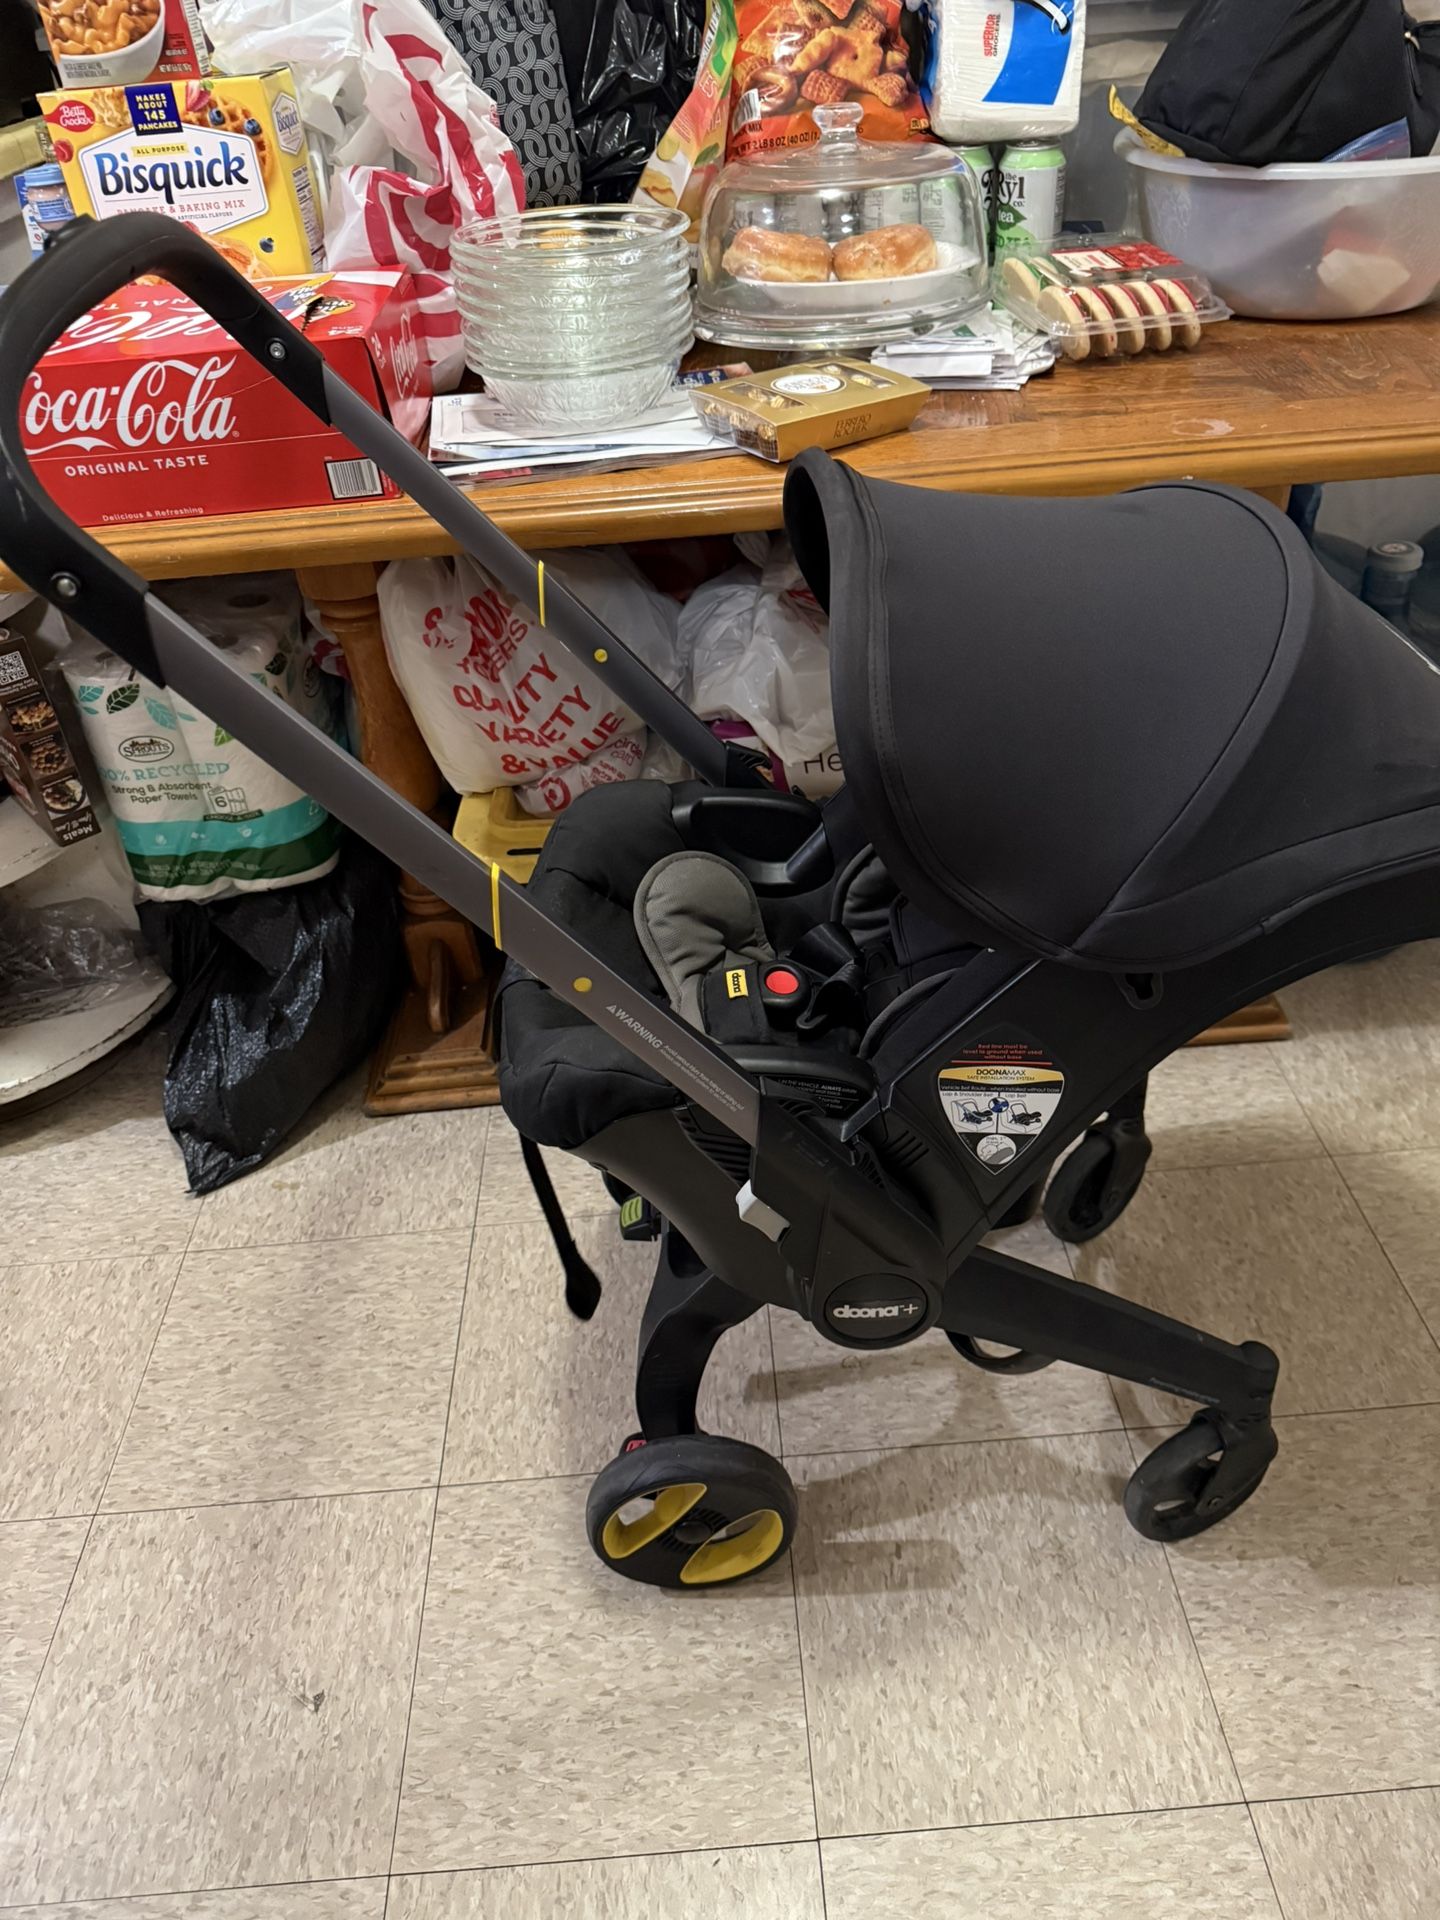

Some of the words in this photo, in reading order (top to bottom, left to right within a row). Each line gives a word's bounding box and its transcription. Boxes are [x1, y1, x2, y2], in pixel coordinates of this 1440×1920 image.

[982, 13, 996, 57] SUPERIOR
[992, 14, 1001, 57] GROCERS
[135, 93, 167, 103] MAKES
[138, 101, 168, 110] ABOUT
[144, 110, 166, 122] 145
[138, 120, 179, 131] PANCAKES
[748, 122, 763, 132] MIX
[775, 136, 786, 147] OZ
[152, 145, 185, 154] PURPOSE
[94, 141, 249, 205] Bisquick
[169, 206, 176, 214] &
[179, 201, 221, 213] BAKING
[225, 199, 246, 209] MIX
[64, 458, 150, 478] ORIGINAL
[153, 454, 210, 470] TASTE
[102, 511, 144, 522] Delicious
[154, 506, 205, 517] Refreshing
[123, 742, 170, 757] SPROUTS
[500, 754, 531, 774] &
[526, 711, 625, 770] VALUE
[133, 762, 230, 781] RECYCLED
[112, 785, 146, 796] Strong
[158, 781, 213, 791] Absorbent
[130, 795, 162, 805] Paper
[163, 792, 198, 801] Towels
[214, 796, 228, 808] 6
[63, 824, 94, 841] Meals
[615, 1008, 663, 1049] WARNING
